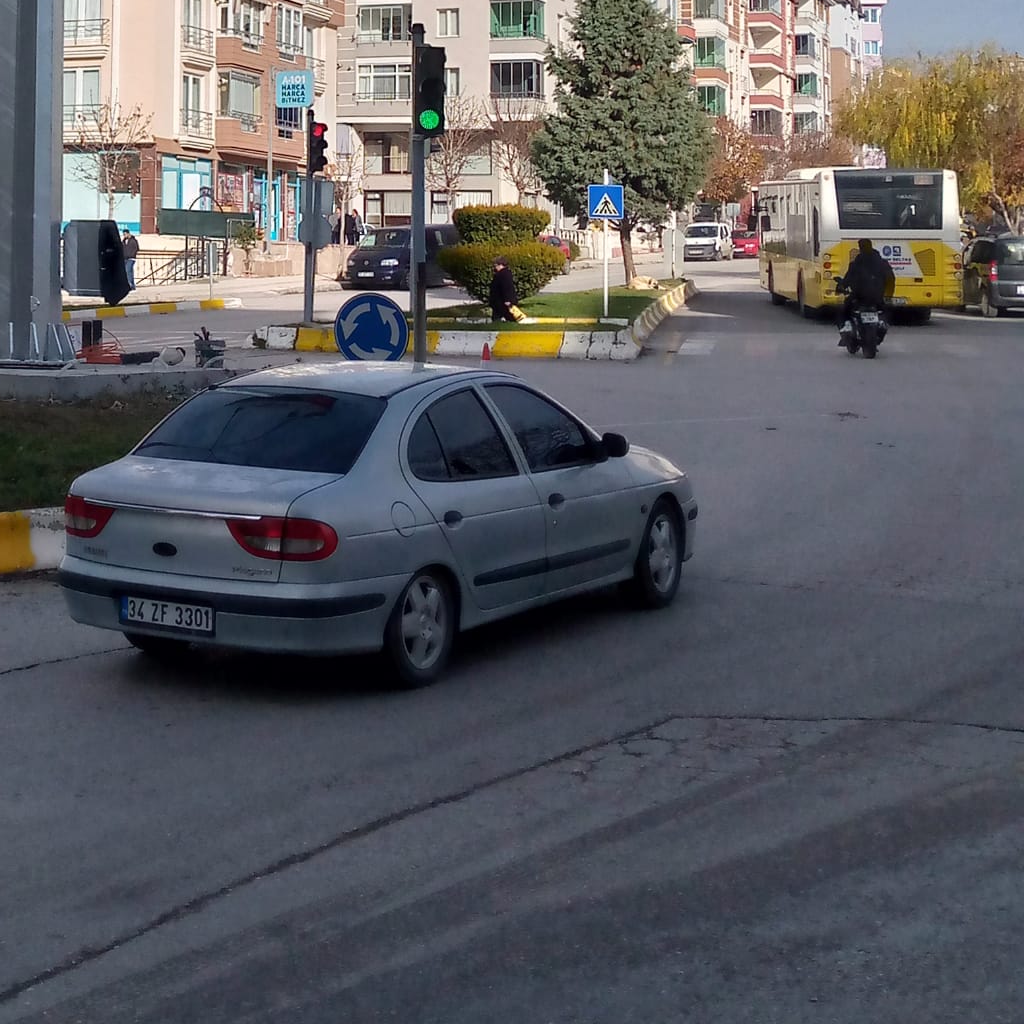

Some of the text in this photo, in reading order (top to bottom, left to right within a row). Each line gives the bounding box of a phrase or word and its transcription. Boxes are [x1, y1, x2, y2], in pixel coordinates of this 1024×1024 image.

[129, 600, 210, 629] 34 ZF 3301
